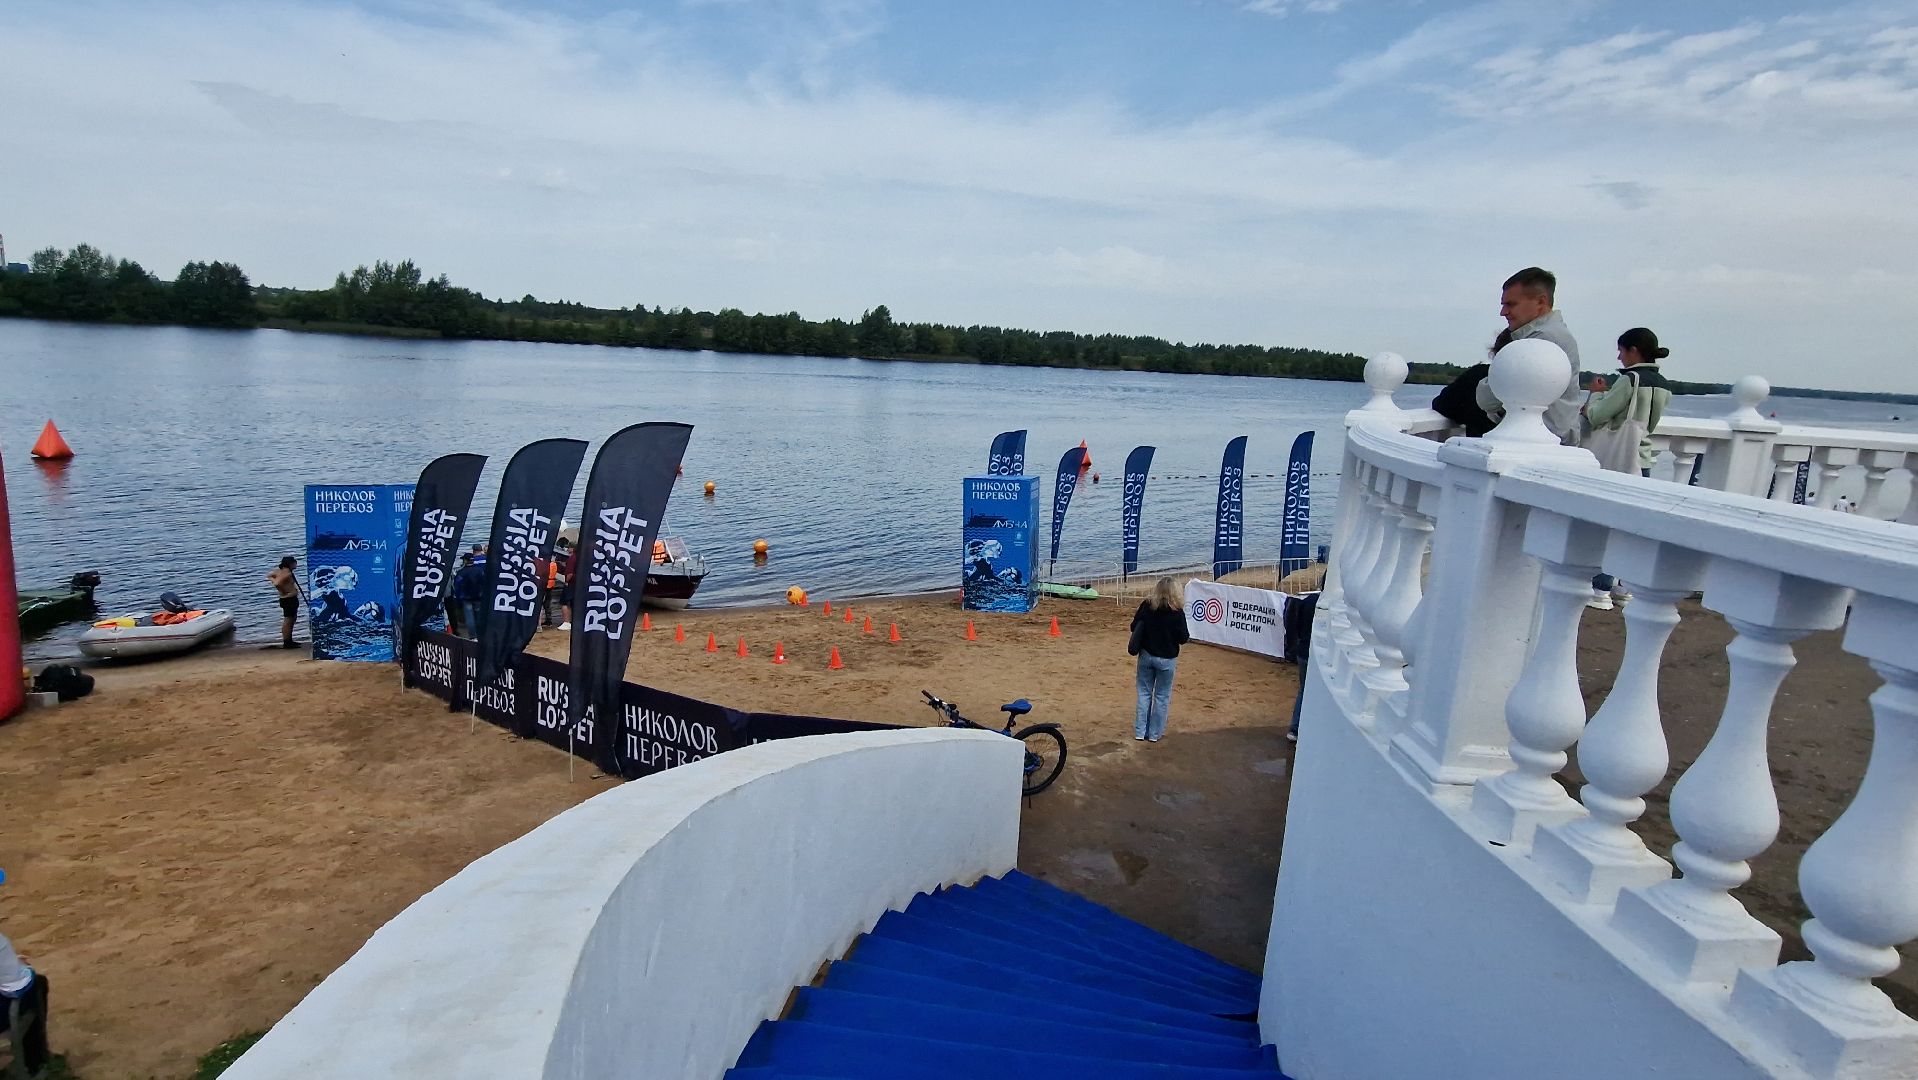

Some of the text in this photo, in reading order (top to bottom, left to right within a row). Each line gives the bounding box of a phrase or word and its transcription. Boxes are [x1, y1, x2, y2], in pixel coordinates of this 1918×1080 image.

[315, 490, 376, 501] НИКОЛОВ
[316, 502, 374, 513] ПЕРЕВОЗ
[393, 490, 415, 501] НИКО
[972, 482, 1021, 492] НИКОЛОВ
[972, 491, 1018, 500] ПЕРЕВОЗ
[1218, 466, 1233, 547] НИКОЛОВ
[1228, 467, 1242, 547] ПЕРЕВОЗ
[1284, 461, 1300, 545] НИКОЛОВ
[412, 508, 441, 599] RUSSIA
[424, 509, 458, 598] LOPPET
[494, 507, 534, 613] RUSSIA
[516, 508, 551, 617] LOPPET
[584, 506, 626, 633] RUSSIA
[606, 508, 648, 640] LOPPET
[1230, 621, 1262, 633] РОССИИ
[1231, 611, 1276, 626] ТРИАТЛОНА
[1232, 601, 1276, 616] ФЕДЕРАЦИЯ
[417, 640, 452, 669] RUSSIA
[537, 675, 595, 720] RUSA
[537, 702, 594, 745] LOPET
[625, 703, 718, 754] НИКОЛОВ
[626, 733, 702, 770] ПЕРЕВ
